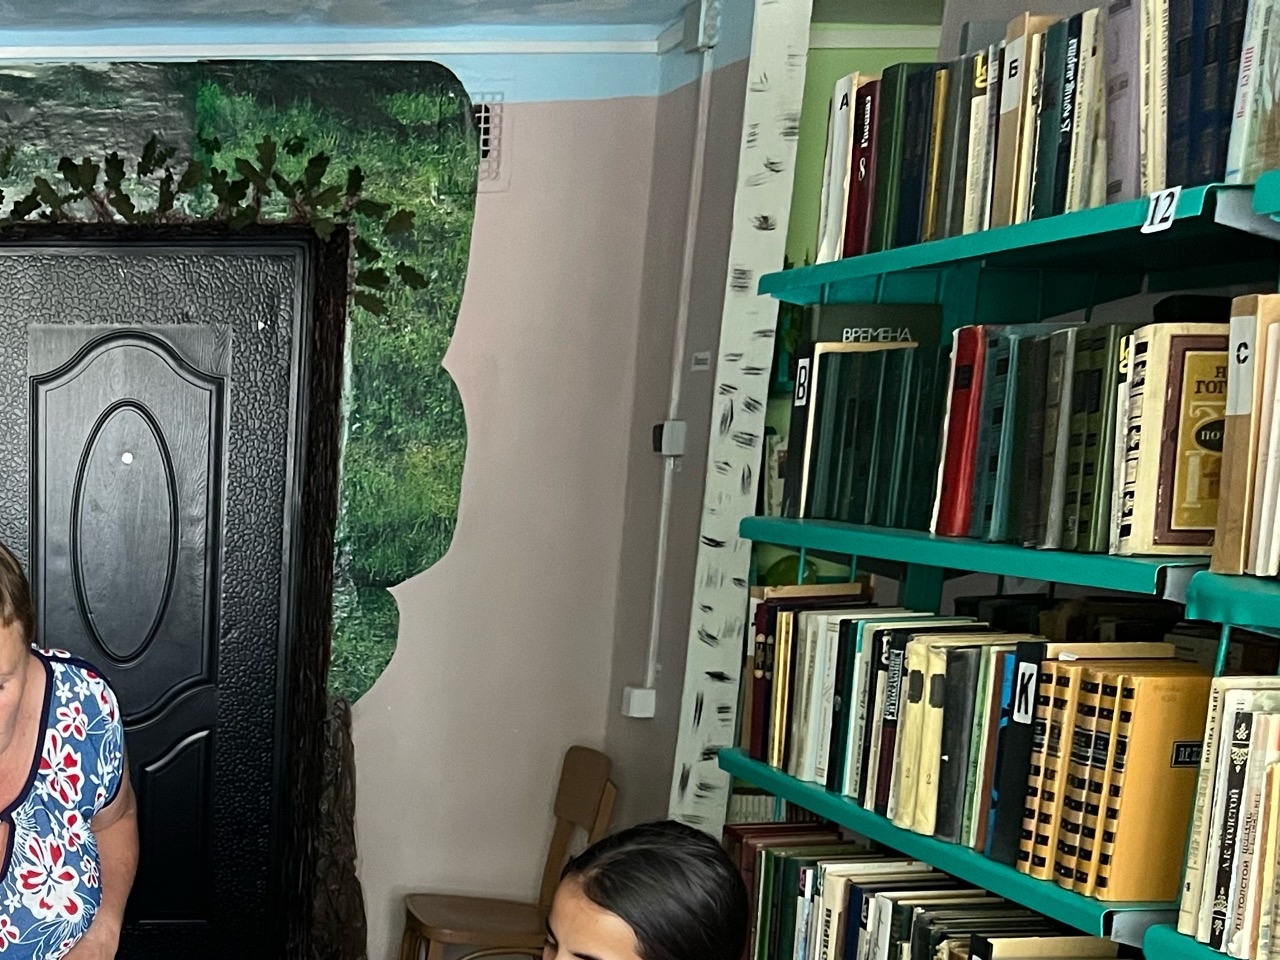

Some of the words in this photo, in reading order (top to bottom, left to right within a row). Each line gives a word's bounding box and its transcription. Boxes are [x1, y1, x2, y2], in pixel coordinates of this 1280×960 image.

[1008, 58, 1019, 80] Б
[839, 92, 849, 111] А
[1147, 191, 1175, 226] 12
[842, 327, 913, 343] ВРЕМЕНА
[1236, 341, 1249, 365] С
[796, 365, 807, 400] В
[1016, 669, 1035, 717] К
